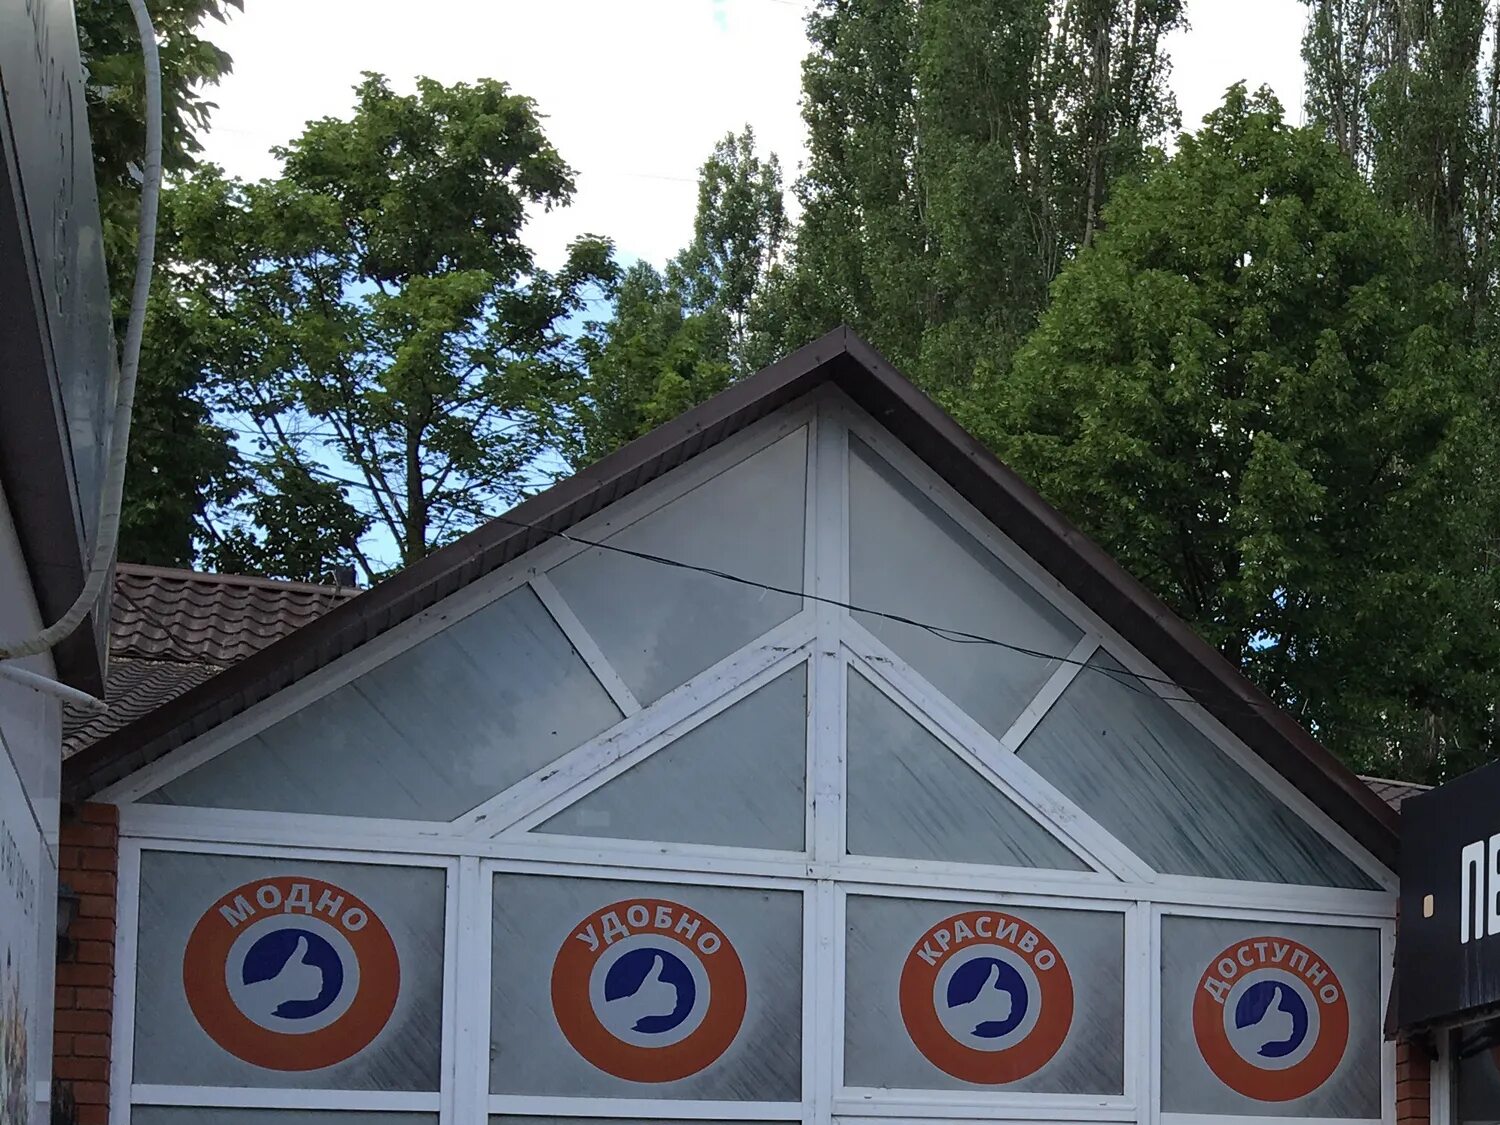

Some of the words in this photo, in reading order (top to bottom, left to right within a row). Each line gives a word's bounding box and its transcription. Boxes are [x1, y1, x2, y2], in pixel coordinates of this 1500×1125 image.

[218, 883, 369, 934] МОДНО
[575, 904, 721, 956] УДОБНО
[917, 915, 1055, 972] КРАСИВО
[1203, 942, 1339, 1005] ДОСТУПНО
